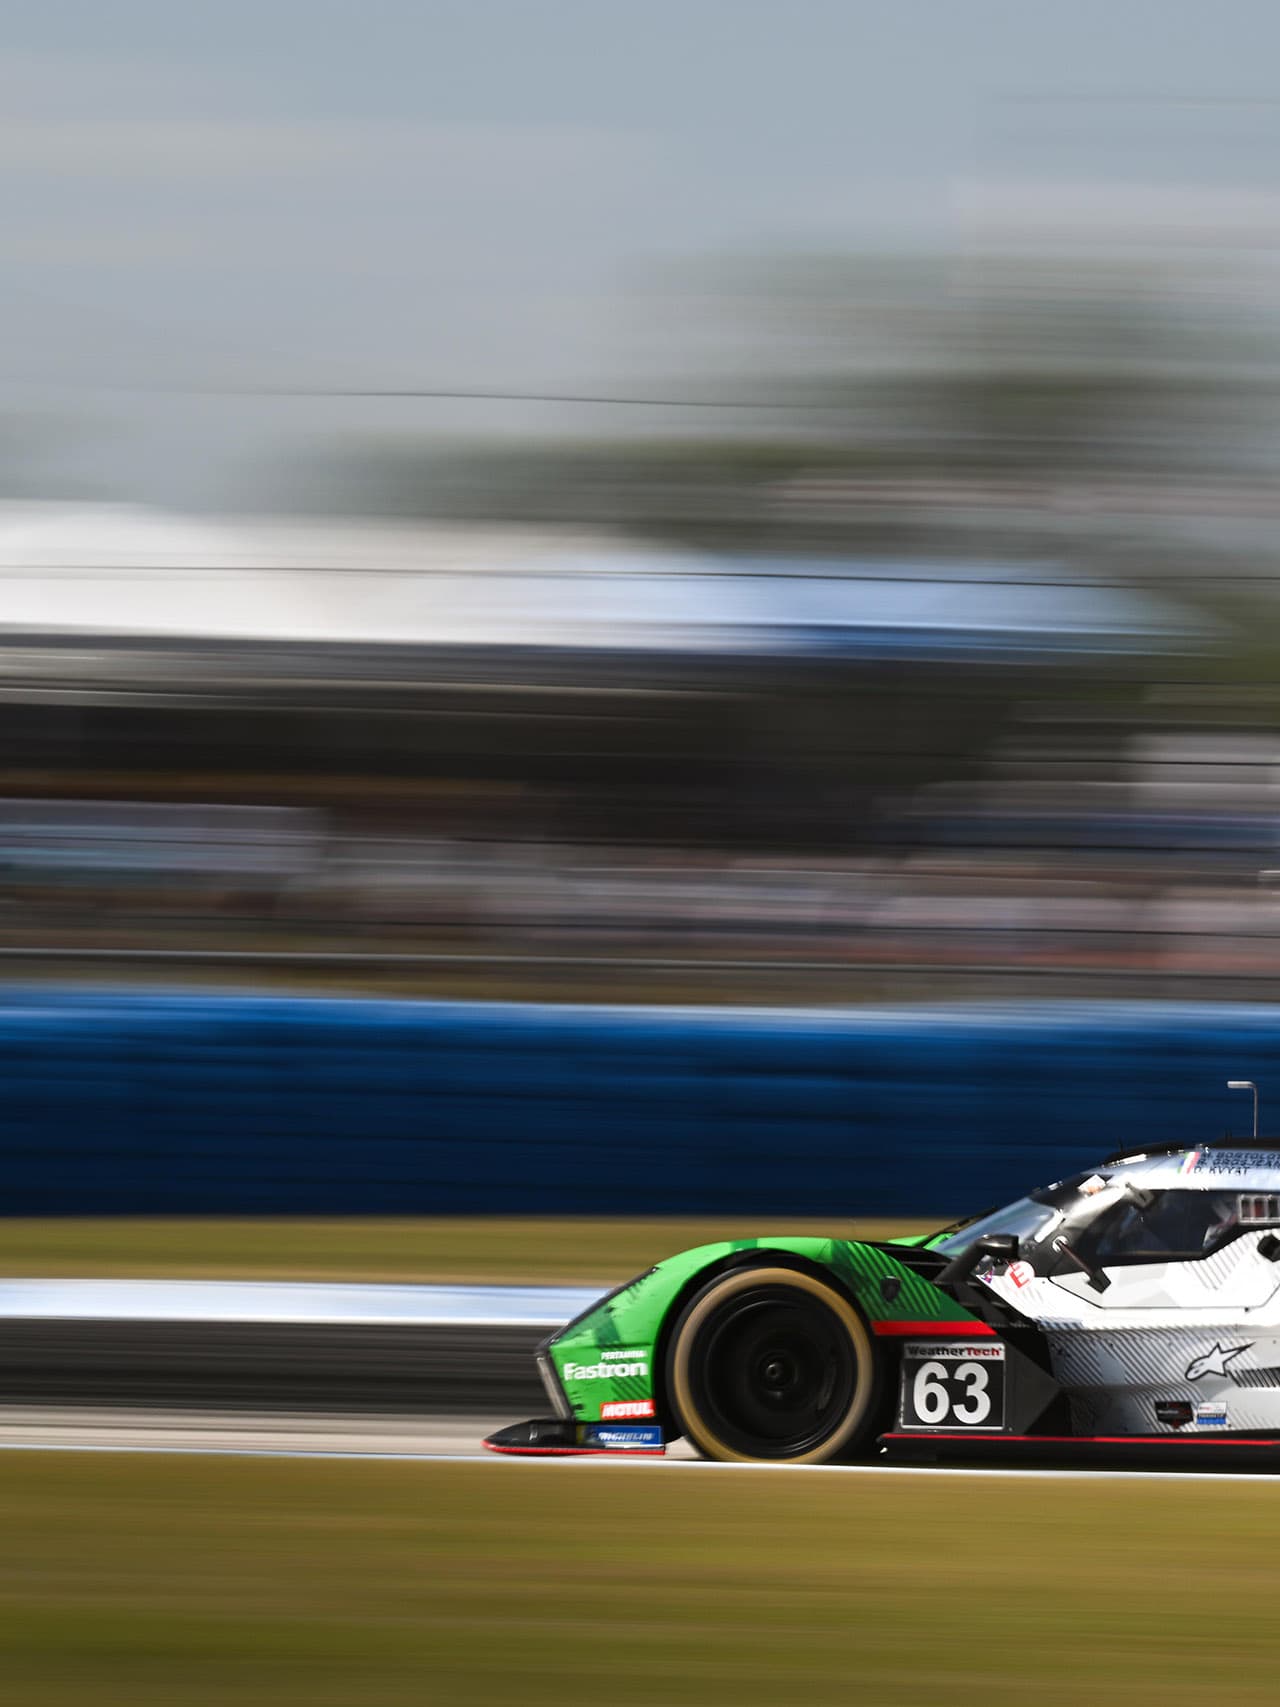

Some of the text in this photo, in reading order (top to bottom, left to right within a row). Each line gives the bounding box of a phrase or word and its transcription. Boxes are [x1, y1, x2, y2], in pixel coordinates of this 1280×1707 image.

[1009, 1263, 1030, 1288] E
[908, 1346, 1001, 1357] WeatherTech
[563, 1362, 648, 1381] Fastron
[913, 1361, 992, 1424] 63
[602, 1402, 654, 1418] MOTUL
